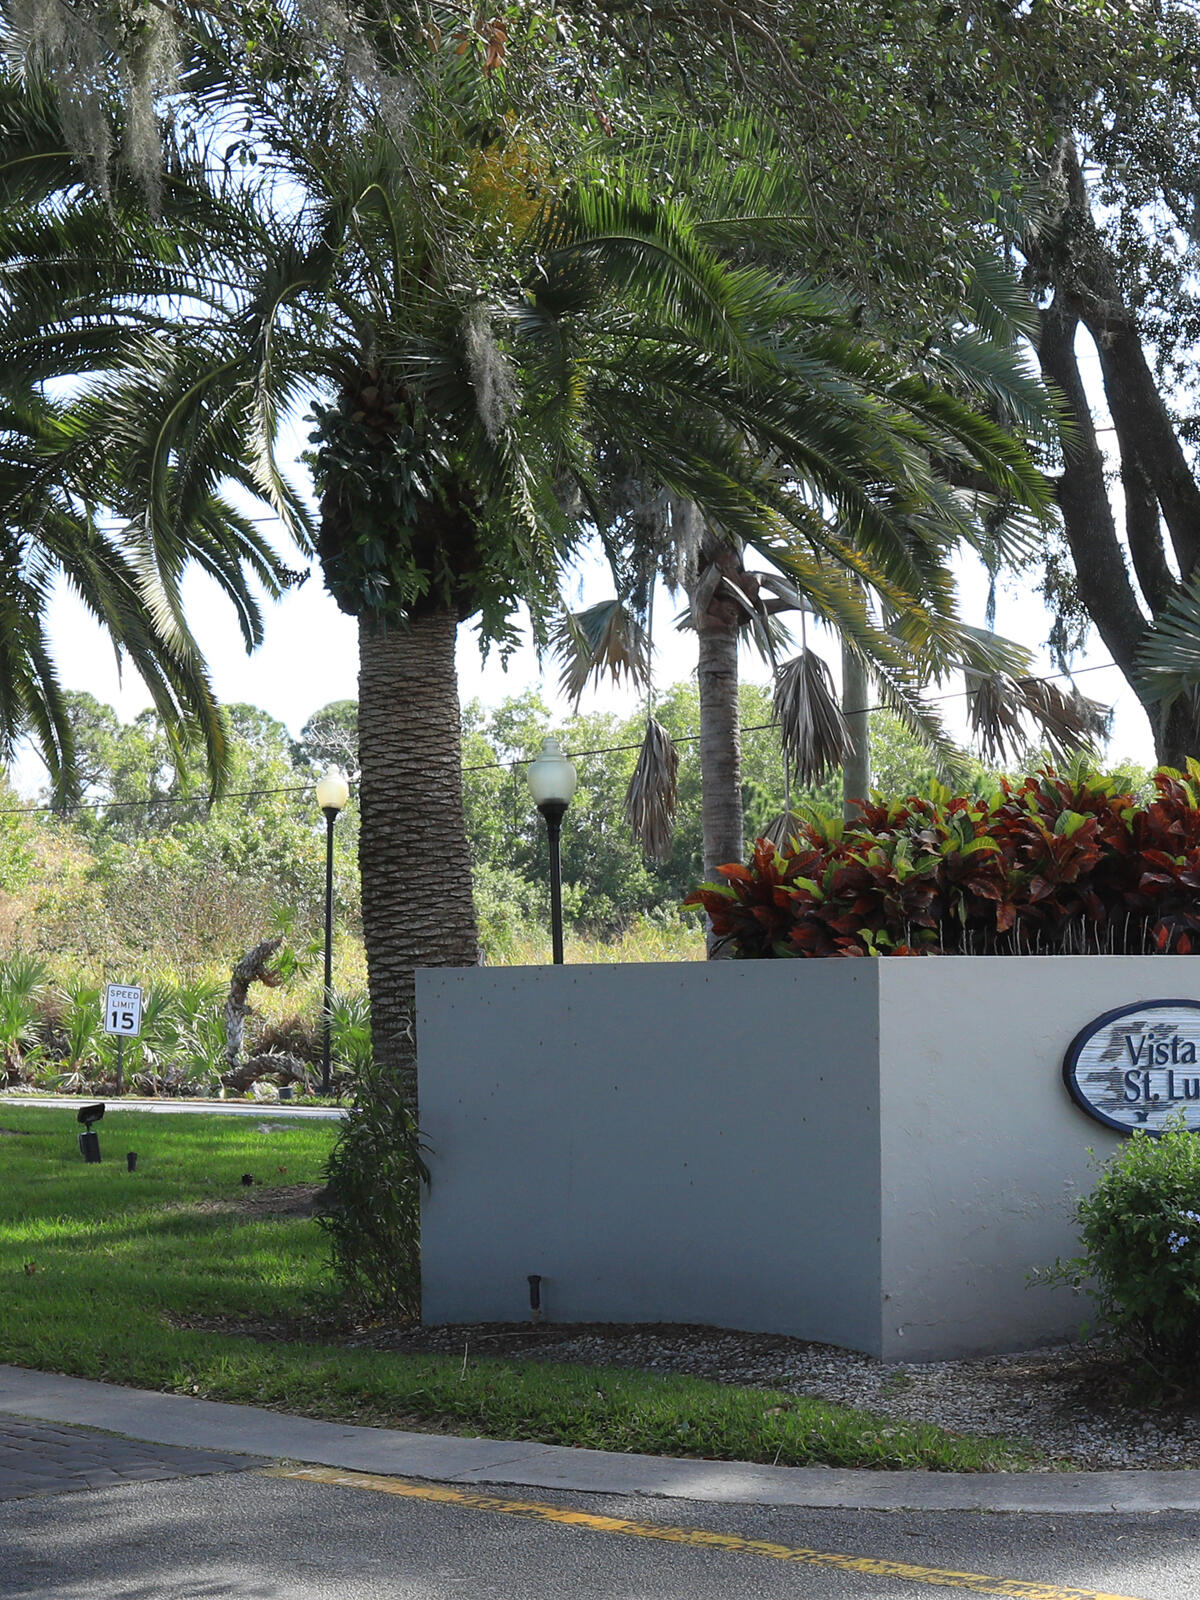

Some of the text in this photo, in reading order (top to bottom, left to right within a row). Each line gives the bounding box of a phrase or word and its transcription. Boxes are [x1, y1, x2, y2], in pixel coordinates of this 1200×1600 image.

[110, 990, 139, 999] SPEED
[112, 1000, 135, 1009] LIMIT
[112, 1011, 134, 1029] 15
[1125, 1033, 1198, 1066] Vista
[1124, 1069, 1160, 1102] St.
